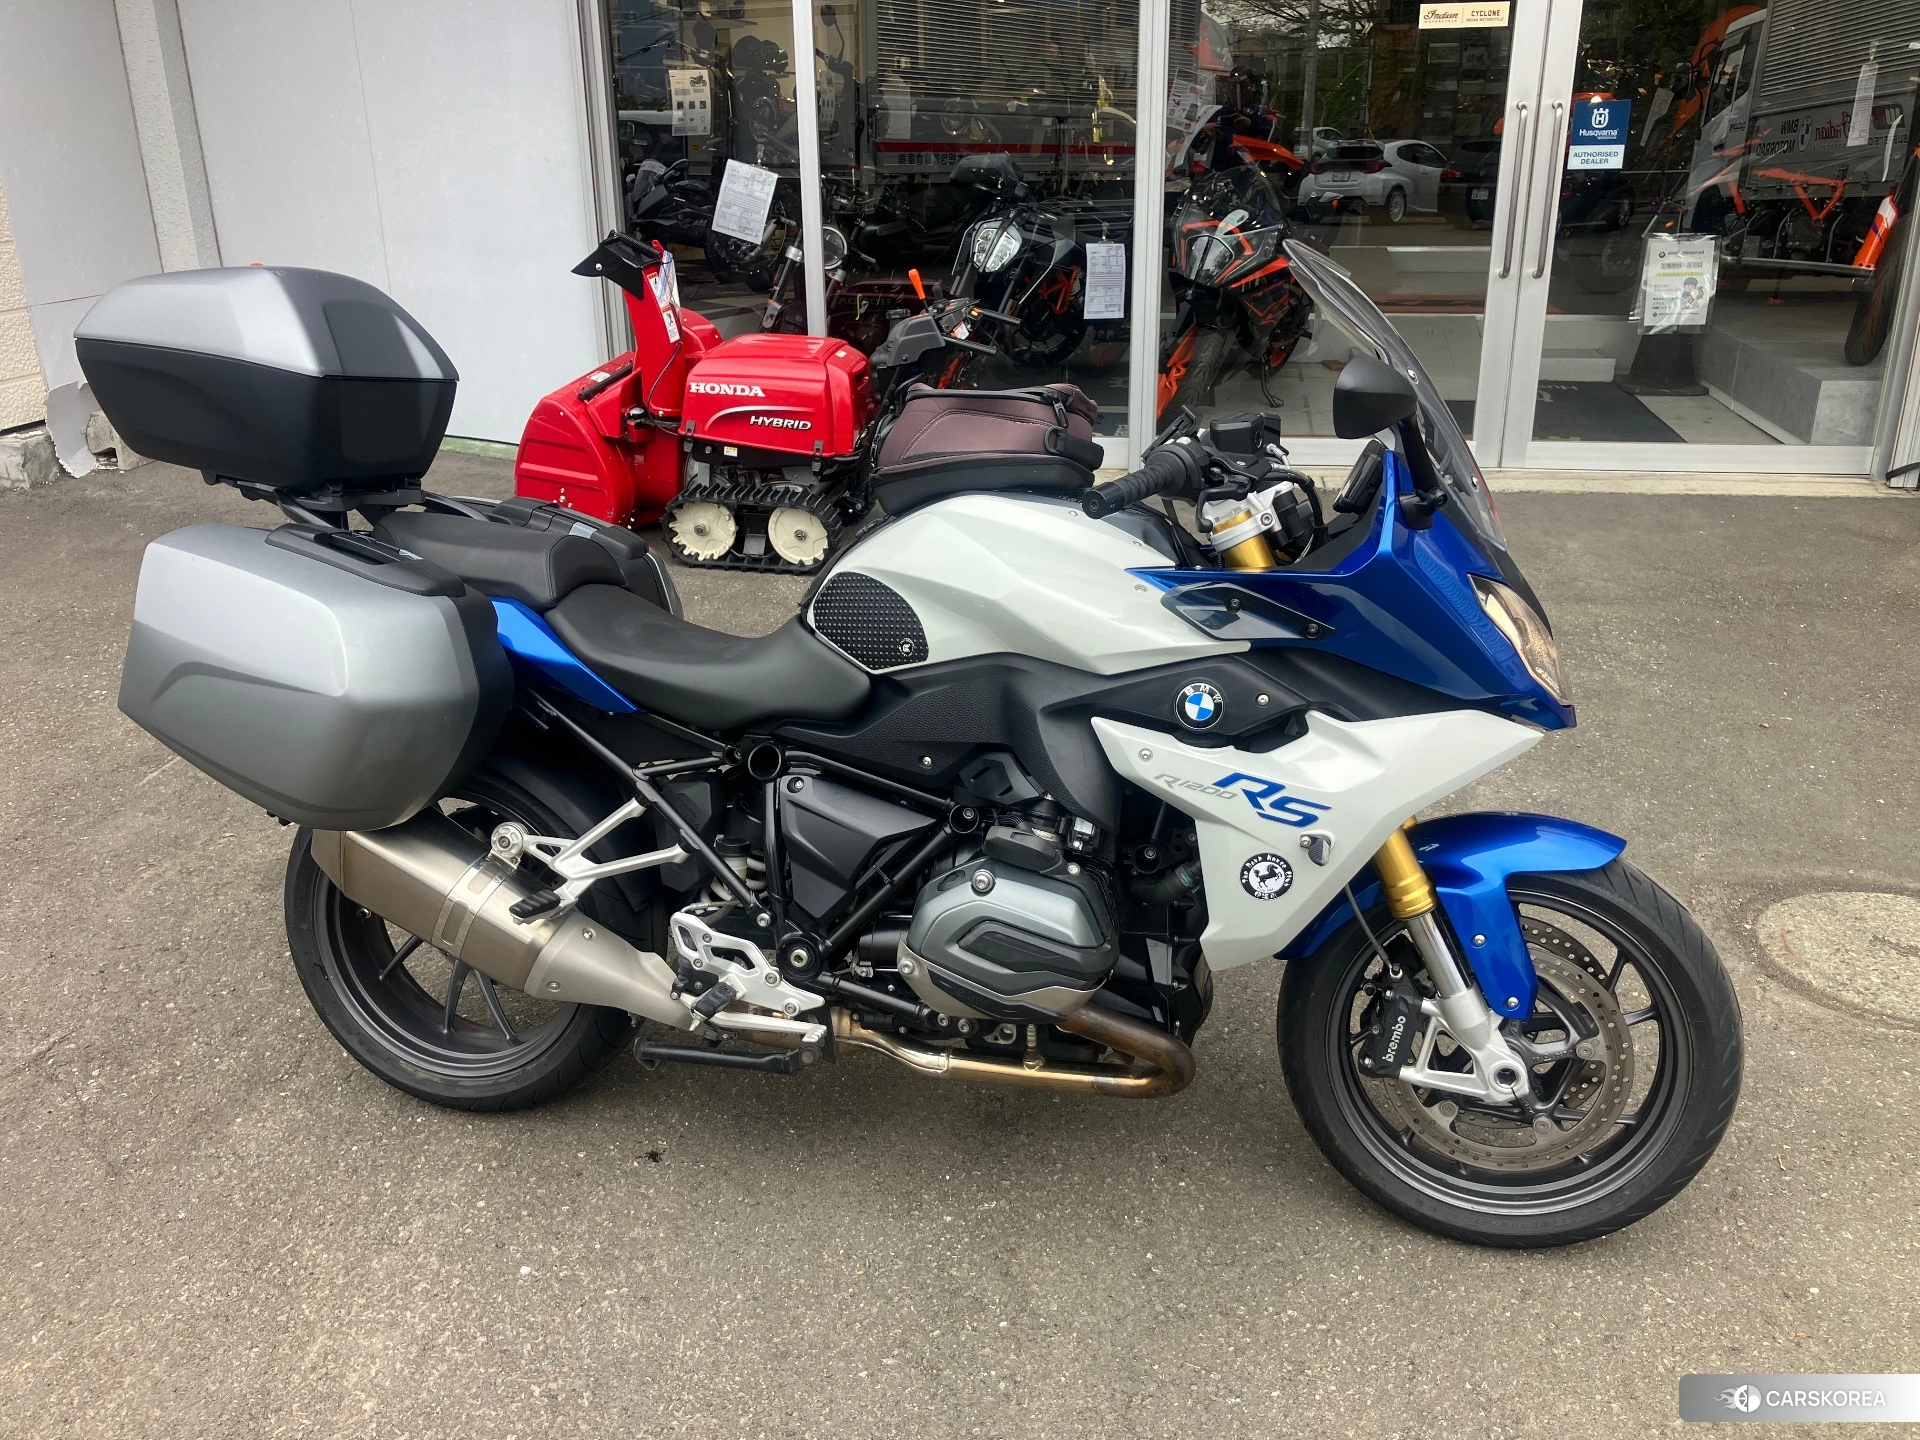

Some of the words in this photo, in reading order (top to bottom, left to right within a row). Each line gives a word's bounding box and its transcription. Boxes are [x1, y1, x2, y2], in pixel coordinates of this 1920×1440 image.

[1423, 9, 1459, 20] Indian
[1471, 9, 1501, 17] CYCLONE
[1578, 128, 1618, 137] Husqvarna
[689, 381, 766, 398] HONDA
[749, 415, 812, 431] HYBRID
[1184, 684, 1223, 704] BMW
[1153, 773, 1238, 800] R1200
[1212, 772, 1333, 828] RS
[1381, 1015, 1407, 1063] brembo
